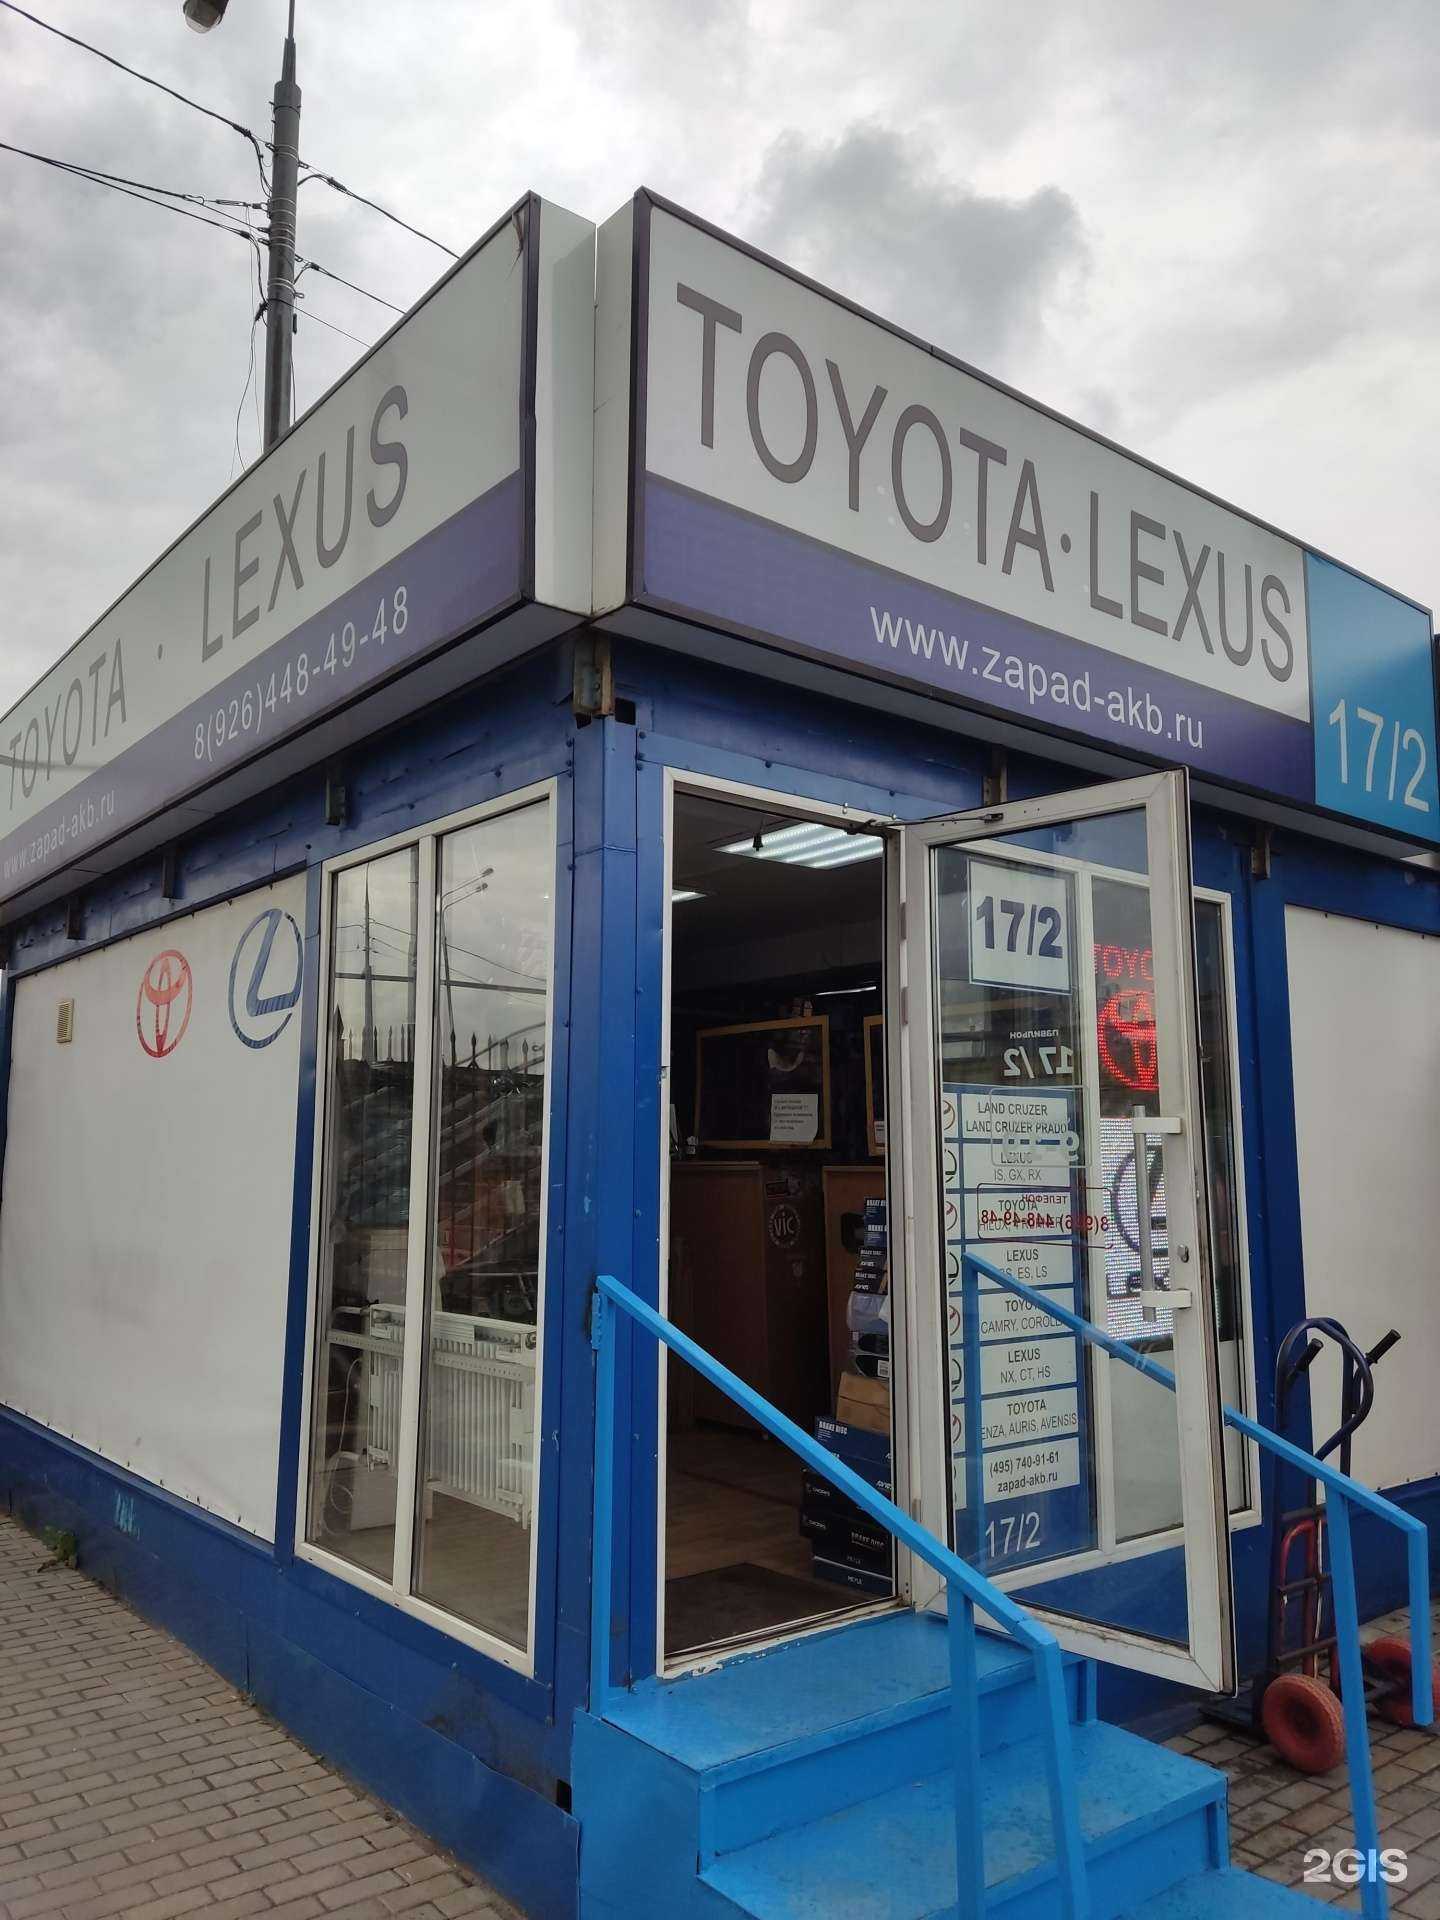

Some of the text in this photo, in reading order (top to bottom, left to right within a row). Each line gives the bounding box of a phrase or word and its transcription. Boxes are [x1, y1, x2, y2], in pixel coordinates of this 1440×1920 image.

[676, 281, 1295, 684] TOYOTA LEXUS
[9, 384, 410, 811] TOYOTA LEXUS
[194, 585, 409, 762] 8(926)448-49-48
[869, 605, 1204, 749] www.zapad-akb.ru
[1328, 698, 1430, 813] 17/2
[3, 789, 116, 880] www.zapad-akb.ru
[975, 895, 1064, 960] 17/2
[978, 1102, 1048, 1116] LAND CRUZER
[966, 1120, 1067, 1134] LAND CRUZER PRADO
[994, 1169, 1042, 1182] IS, GX, RX
[998, 1200, 1039, 1212] TOYOTA
[1006, 1249, 1039, 1262] LEXUS
[1017, 1267, 1033, 1280] ES,
[1036, 1266, 1048, 1278] LS
[1021, 1316, 1063, 1330] COROLL
[1008, 1348, 1041, 1363] LEXUS
[1000, 1365, 1051, 1384] NX, CT, HS
[1007, 1399, 1047, 1416] TOYOTA
[1040, 1412, 1077, 1431] AVENSIS
[989, 1451, 1060, 1478] (495) 740-91-61
[997, 1471, 1058, 1493] zapad-akb.ru
[985, 1511, 1041, 1558] 17/2
